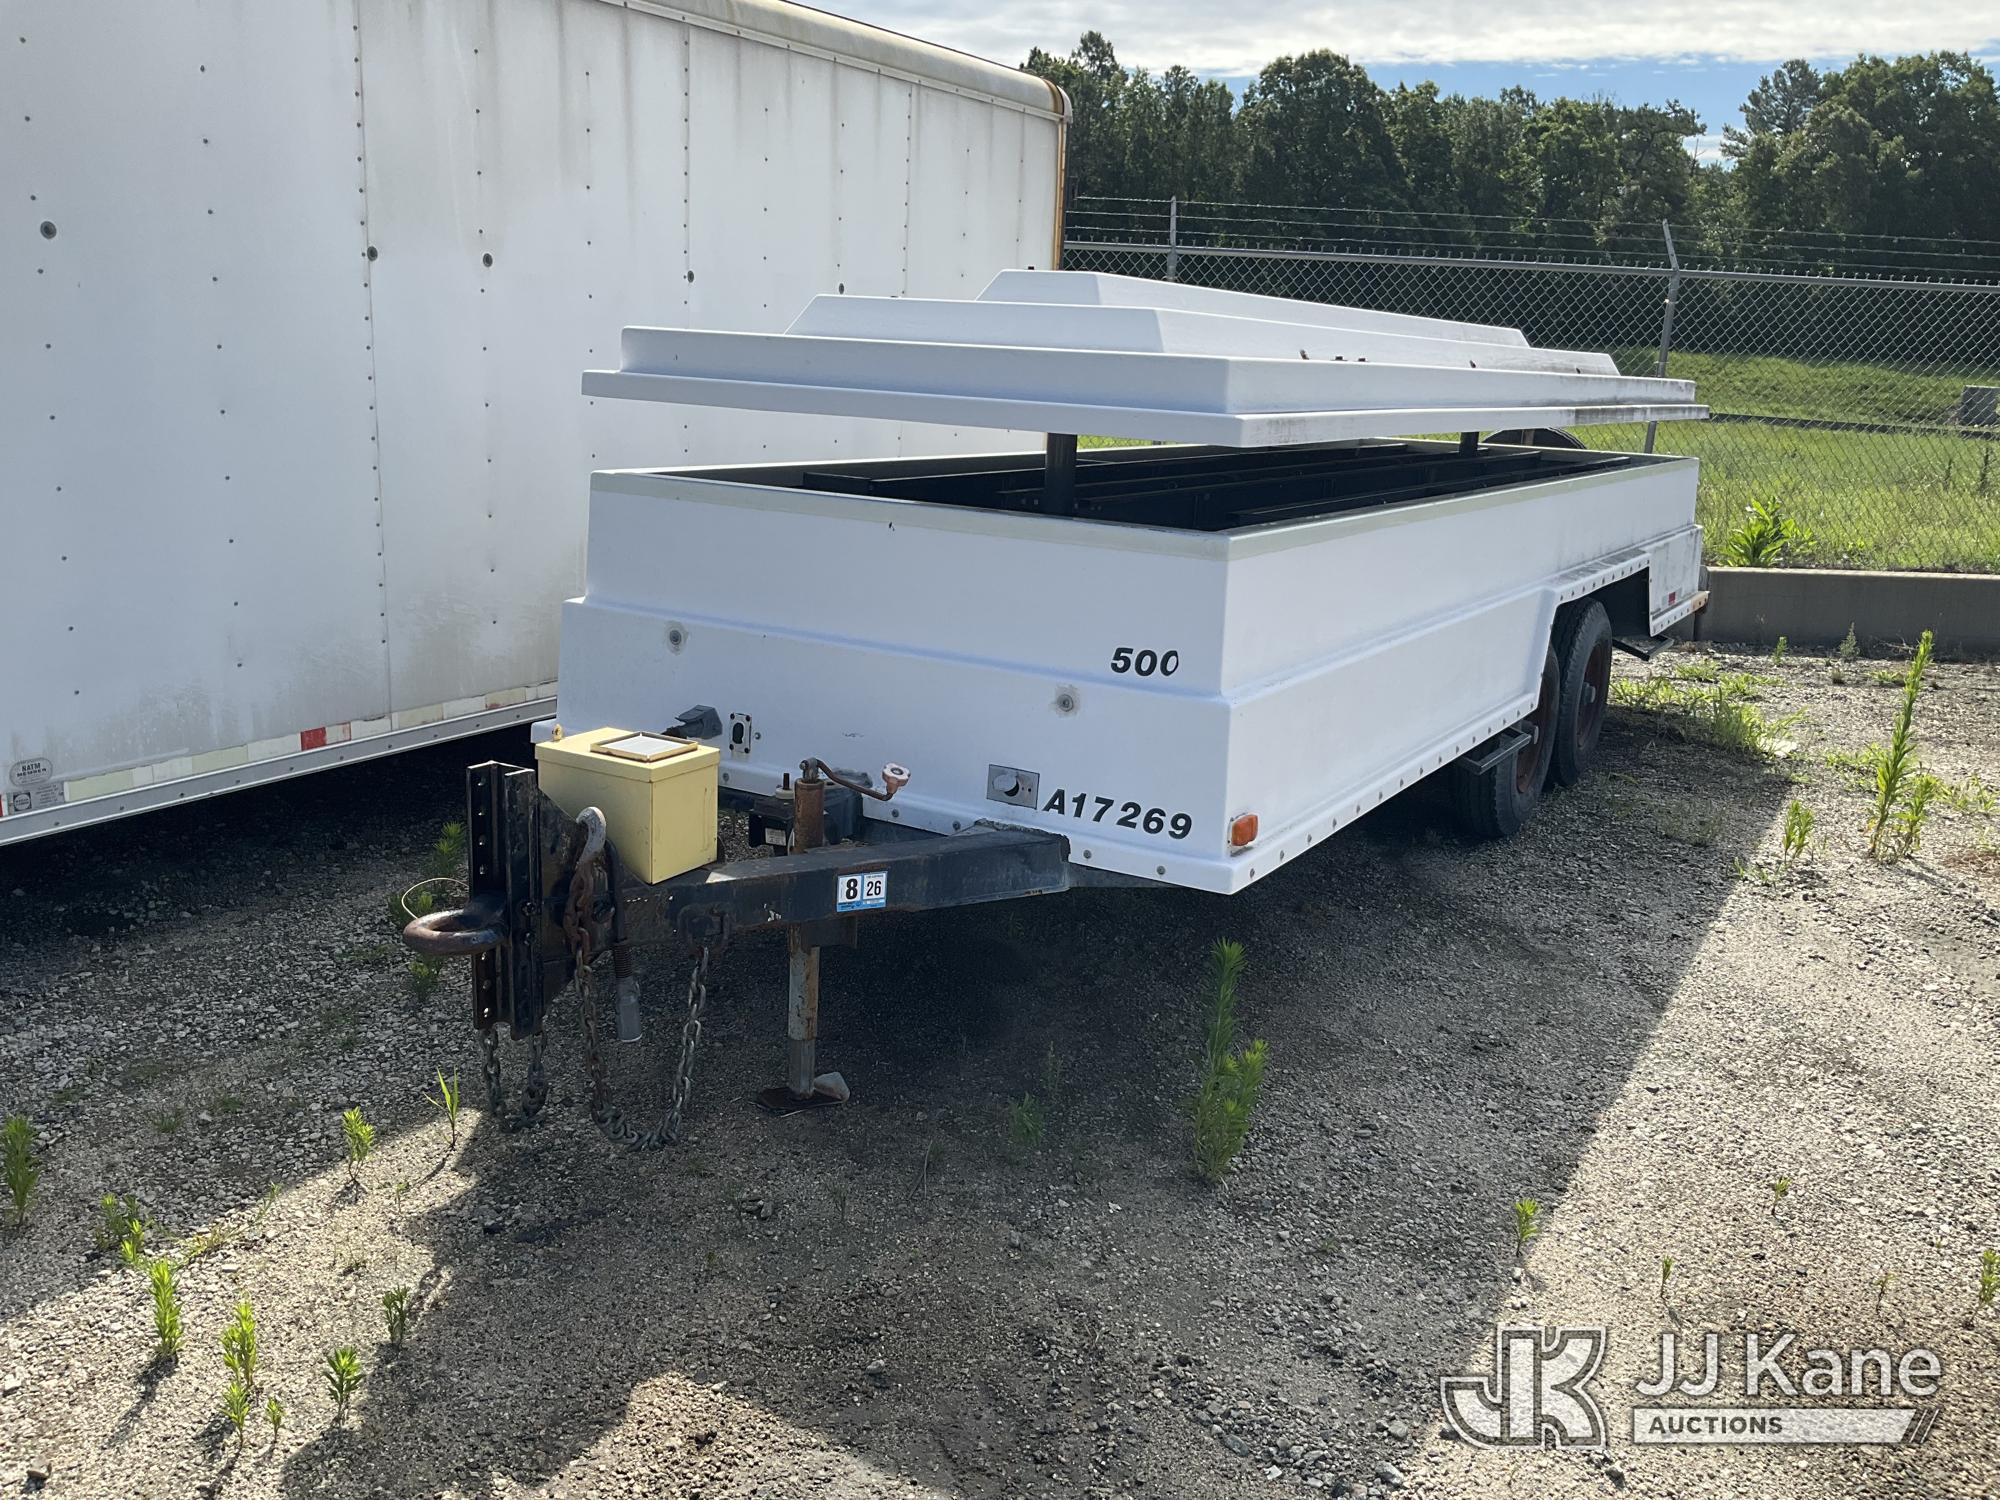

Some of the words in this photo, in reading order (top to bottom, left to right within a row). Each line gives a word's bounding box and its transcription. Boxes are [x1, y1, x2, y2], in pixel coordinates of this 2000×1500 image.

[1110, 647, 1180, 677] 500
[22, 762, 41, 772] NATM
[1041, 788, 1193, 840] A17269
[845, 878, 858, 900] 8
[866, 880, 882, 897] 26
